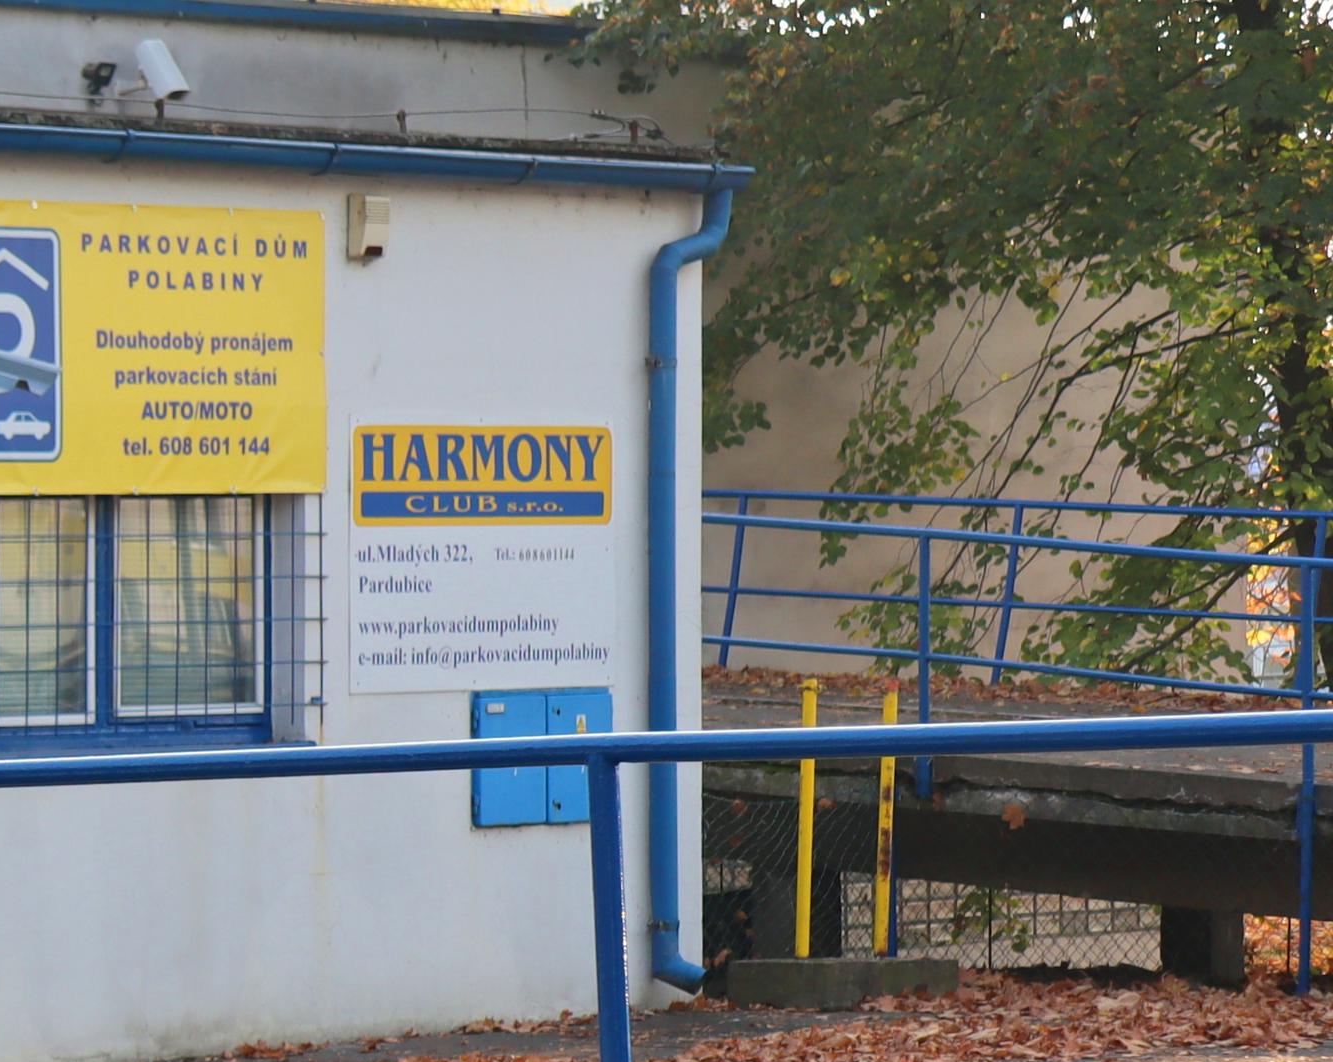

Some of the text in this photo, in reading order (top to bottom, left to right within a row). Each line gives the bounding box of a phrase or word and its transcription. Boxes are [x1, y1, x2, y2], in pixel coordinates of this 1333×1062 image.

[80, 232, 308, 259] PARKOVACÍ DŮM
[128, 269, 264, 292] POLABINY
[95, 329, 293, 356] Dlouhodobý pronájem
[114, 366, 277, 391] parkovacích stání
[141, 400, 253, 421] AUTO/MOTO
[123, 437, 271, 457] tel. 608 601 144
[360, 432, 605, 483] HARMONY
[405, 495, 564, 513] CLUB s.r.o.
[443, 544, 474, 564] 322,
[359, 575, 433, 594] Pardubice
[359, 614, 559, 639] www.parkovacidumpolabiny
[358, 643, 610, 670] e-mail: info@parkovacidumpolabiny
